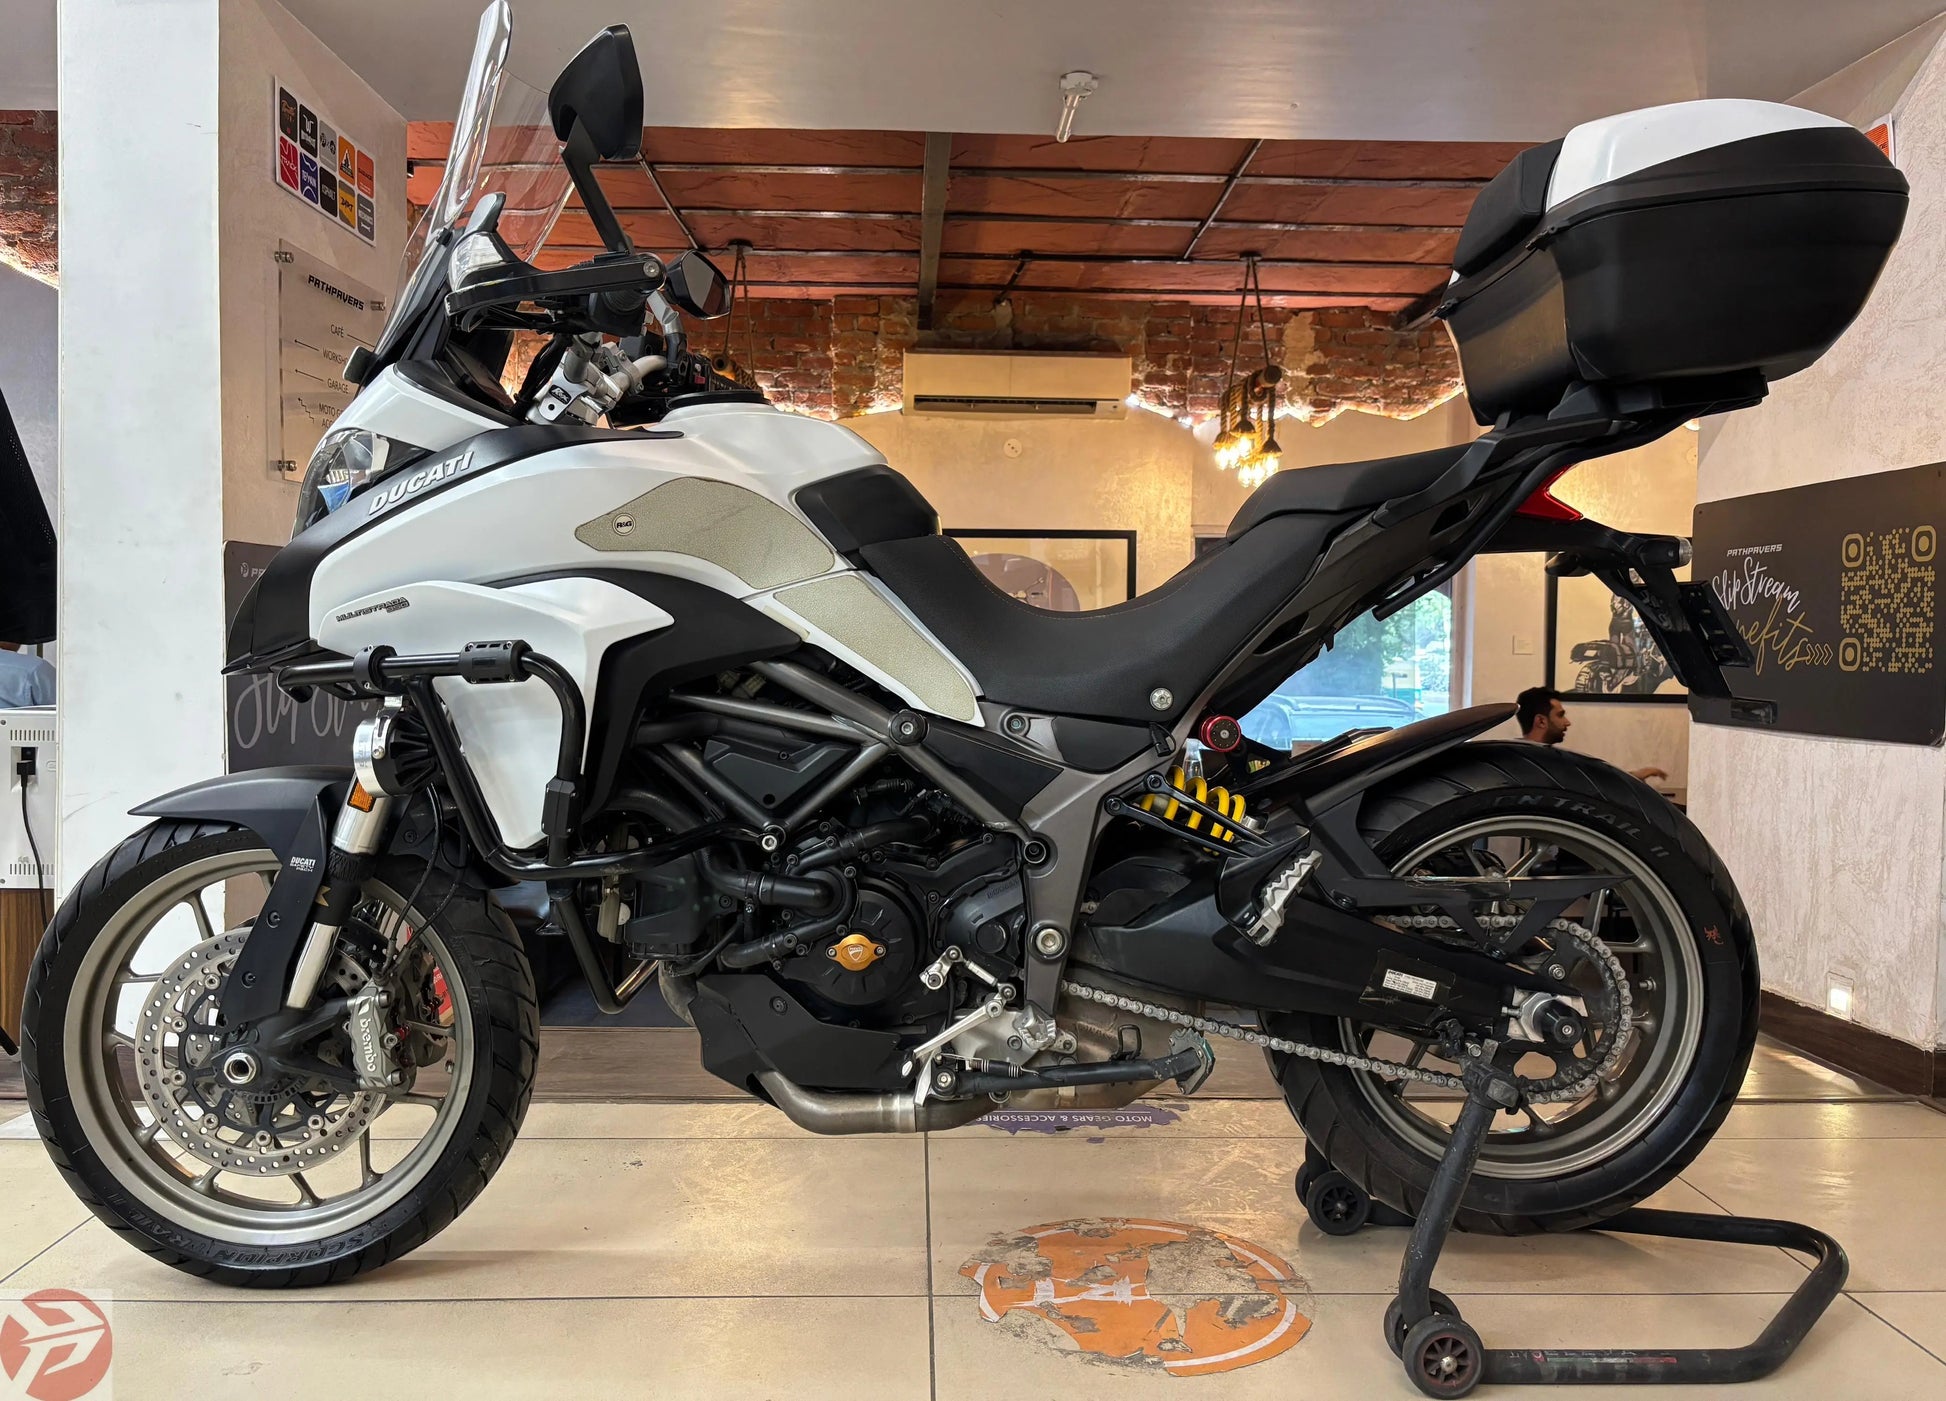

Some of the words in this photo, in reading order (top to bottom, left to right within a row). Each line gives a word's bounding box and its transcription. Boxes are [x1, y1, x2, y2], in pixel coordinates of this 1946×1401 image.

[308, 274, 364, 311] PATHPAVERS
[327, 379, 349, 394] GARAGE
[369, 451, 474, 516] DUCATI
[1726, 543, 1783, 557] PATHPAVERS
[290, 856, 316, 867] DUCATI
[360, 1018, 377, 1072] brembo
